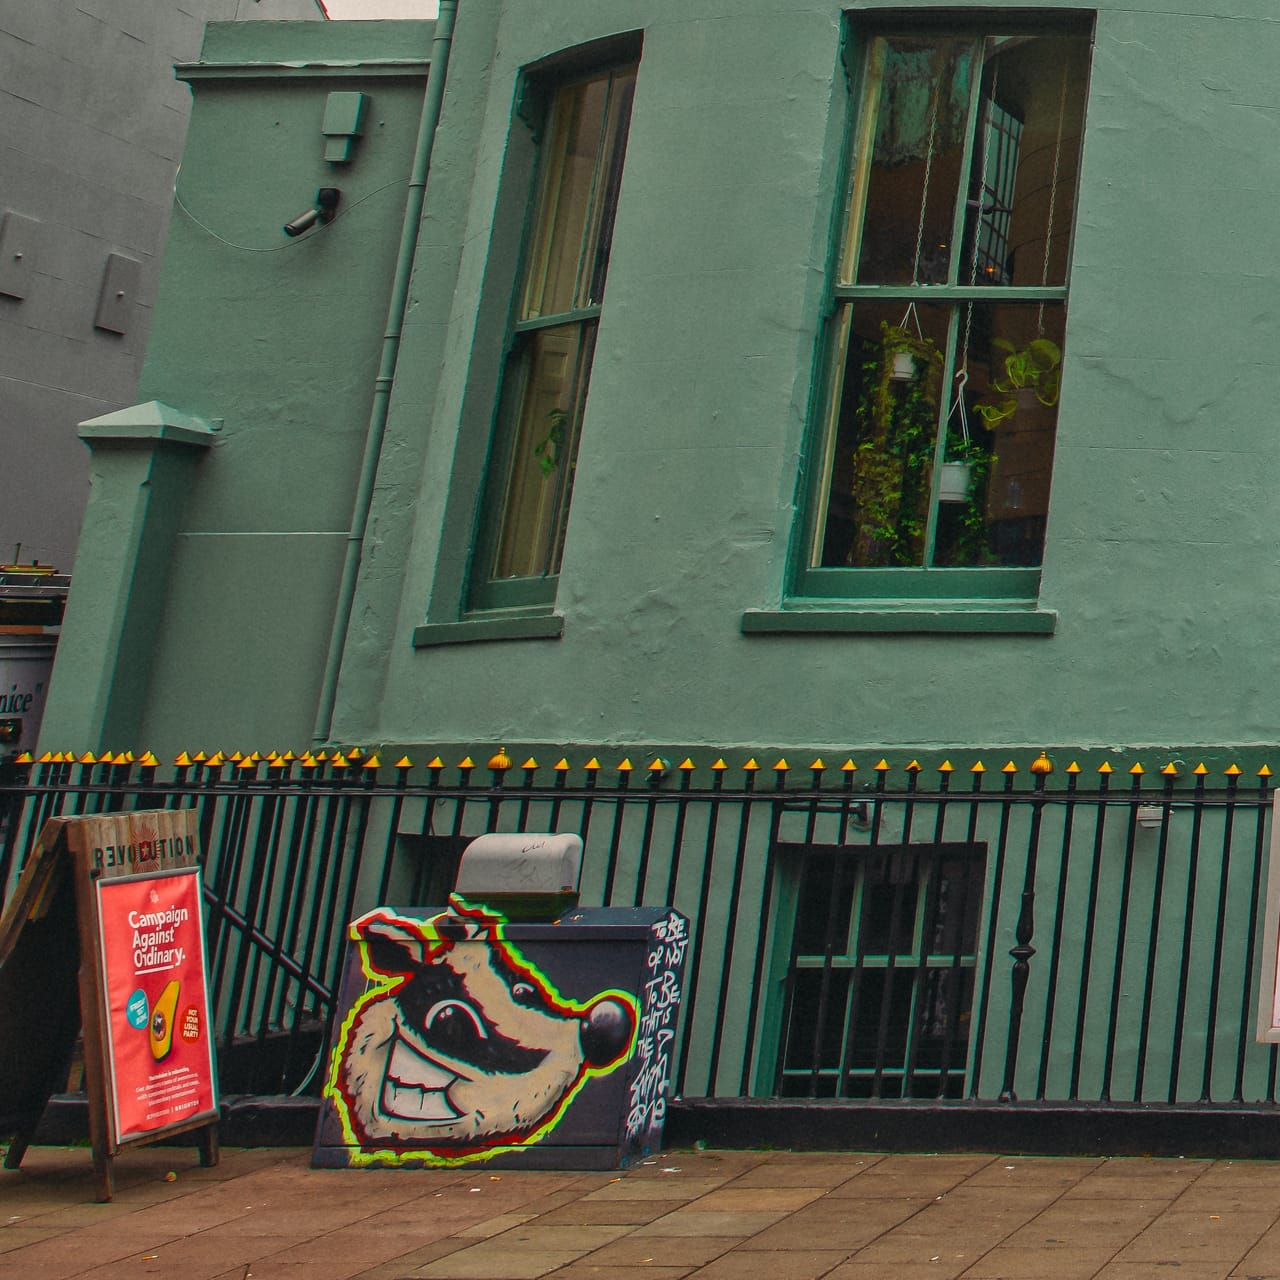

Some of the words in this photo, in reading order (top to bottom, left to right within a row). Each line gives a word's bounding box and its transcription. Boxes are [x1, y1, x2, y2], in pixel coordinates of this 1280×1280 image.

[128, 905, 189, 929] Campaign
[132, 926, 175, 953] Against
[665, 939, 689, 970] NOT
[638, 1036, 654, 1058] THE
